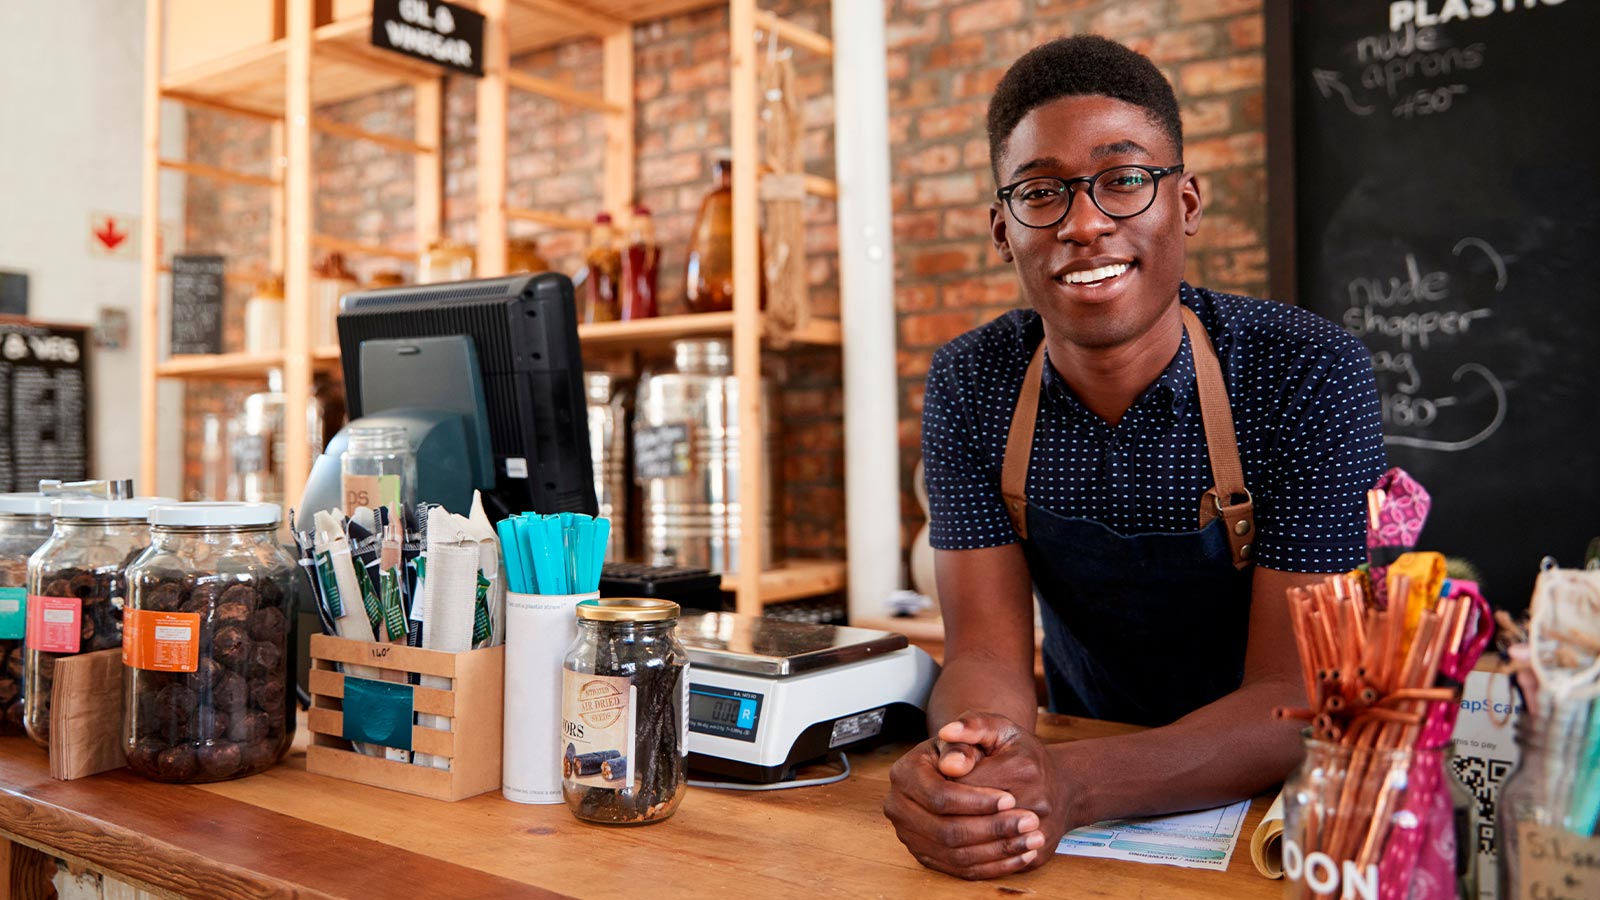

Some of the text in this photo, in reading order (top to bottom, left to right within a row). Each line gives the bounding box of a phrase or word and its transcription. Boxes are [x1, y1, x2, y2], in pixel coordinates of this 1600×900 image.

[1389, 0, 1567, 32] PLAS
[384, 19, 473, 68] VINEGAR
[1357, 23, 1438, 63] nude
[1361, 42, 1487, 98] aprons
[1349, 253, 1449, 308] nude
[28, 335, 80, 363] VEG
[1371, 350, 1421, 394] ag
[582, 697, 620, 712] AIR DRIED
[591, 713, 612, 722] SEEDS
[742, 708, 751, 721] R
[563, 719, 584, 738] ORS
[1470, 739, 1479, 747] to
[1481, 742, 1497, 751] pay
